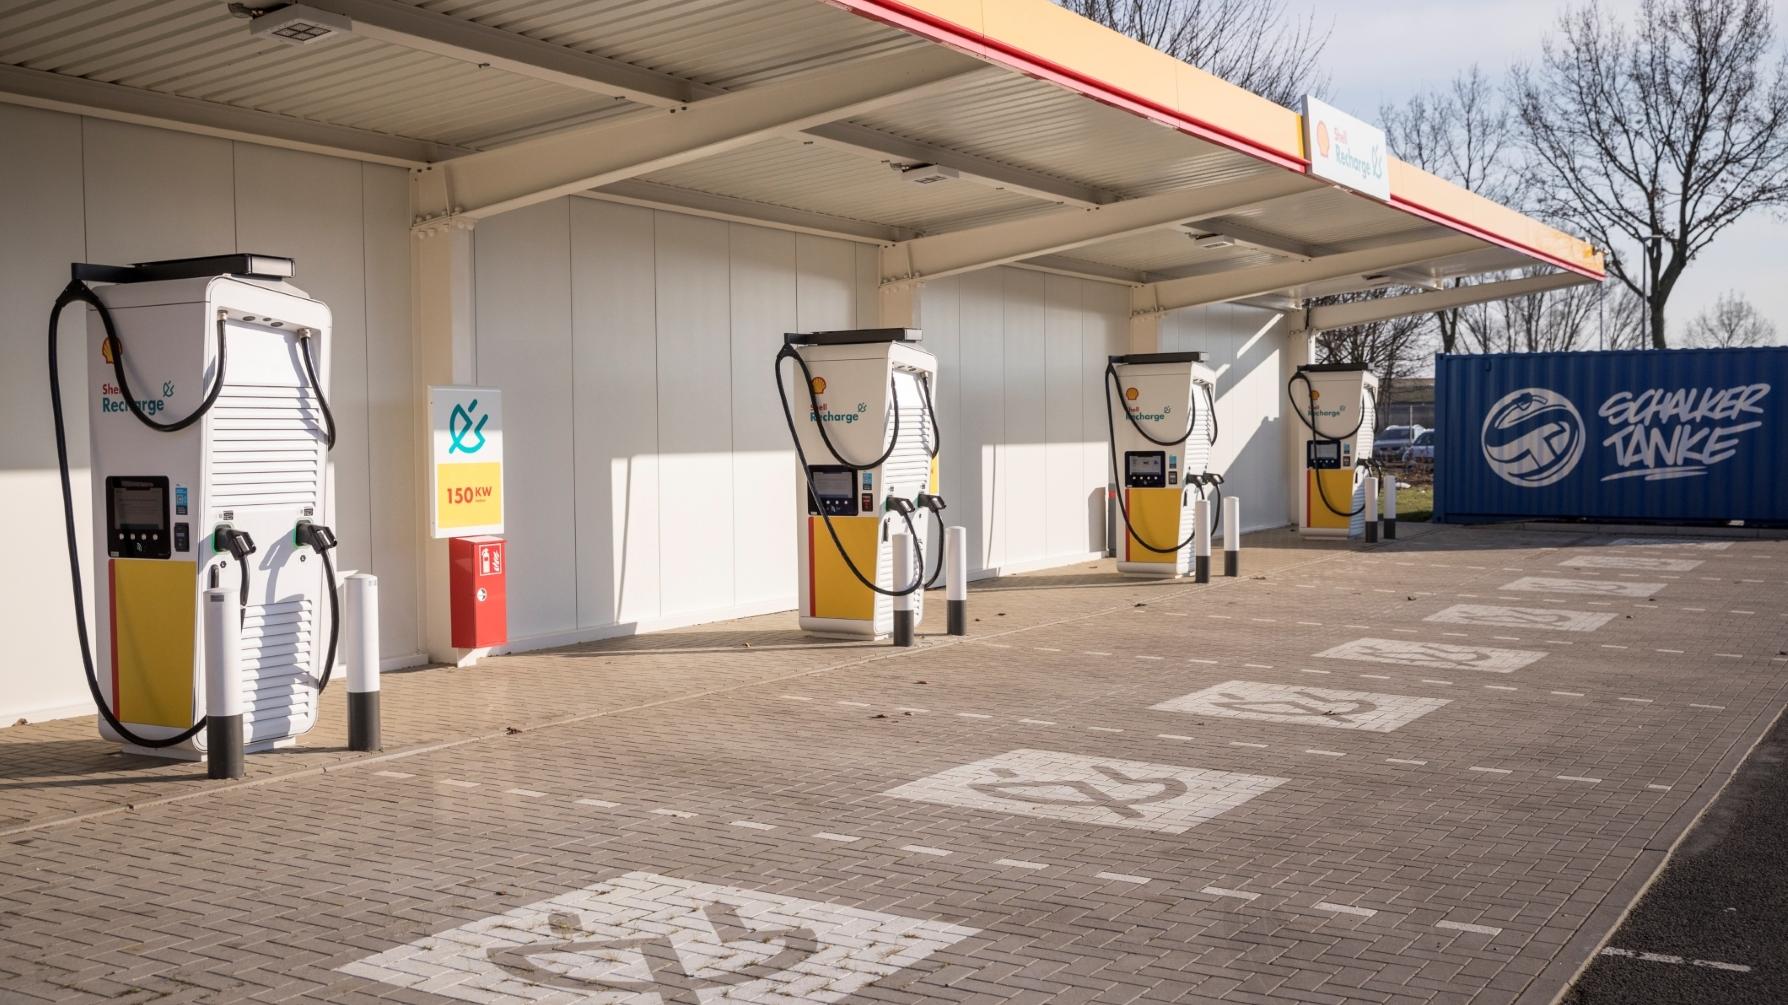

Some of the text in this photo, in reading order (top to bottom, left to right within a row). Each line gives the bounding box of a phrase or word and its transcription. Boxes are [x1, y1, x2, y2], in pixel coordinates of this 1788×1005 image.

[1335, 144, 1371, 179] Recharge
[810, 411, 859, 424] Rcharge
[1598, 383, 1771, 426] SCHALKER
[1602, 421, 1762, 468] TANKE
[447, 486, 493, 504] 150 KW
